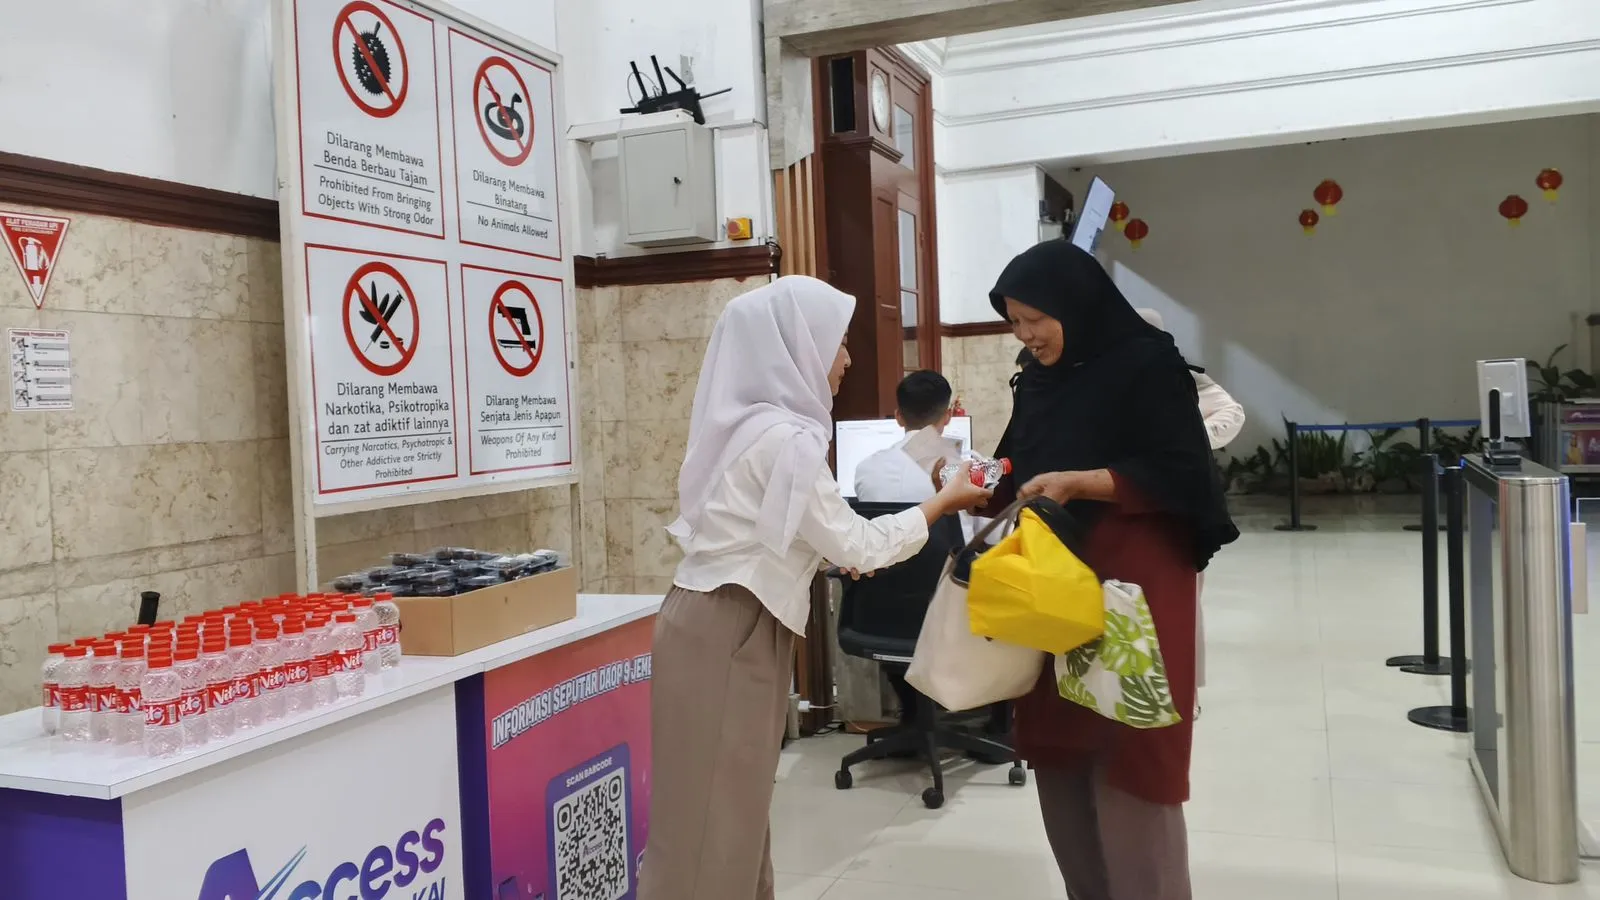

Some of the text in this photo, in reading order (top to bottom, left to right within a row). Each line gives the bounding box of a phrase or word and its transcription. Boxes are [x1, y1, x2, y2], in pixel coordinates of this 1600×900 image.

[327, 131, 424, 167] Dilarang Membawa
[323, 149, 428, 187] Benda Berbau Tajam
[319, 175, 431, 212] Prohibited From Bringing
[472, 169, 545, 199] Dilarang Membawa
[318, 193, 434, 225] Objects With Strong Odor
[494, 193, 528, 215] Binatang
[477, 215, 548, 239] No Animals Allowed
[337, 382, 438, 399] Dilarang Membawa
[325, 399, 449, 416] Narkotika, Psikotropika
[485, 395, 556, 409] Dilarang Membawa
[328, 416, 449, 435] dan zat adiktif lainnya
[480, 409, 561, 425] Senjata Jenis Apapun
[325, 436, 453, 457] Carrying Narcotics, Psychotropic &
[480, 431, 557, 446] Weapons Of Any Kind
[340, 451, 442, 469] Other Addictive are Strictly
[505, 447, 542, 459] Prohibited
[375, 467, 413, 479] Prohibited
[492, 689, 551, 749] INFORMASI
[553, 670, 598, 714] SEPUTAR
[599, 661, 623, 694] DAOP
[623, 659, 630, 685] 9
[566, 756, 613, 788] SCAN BARCODE
